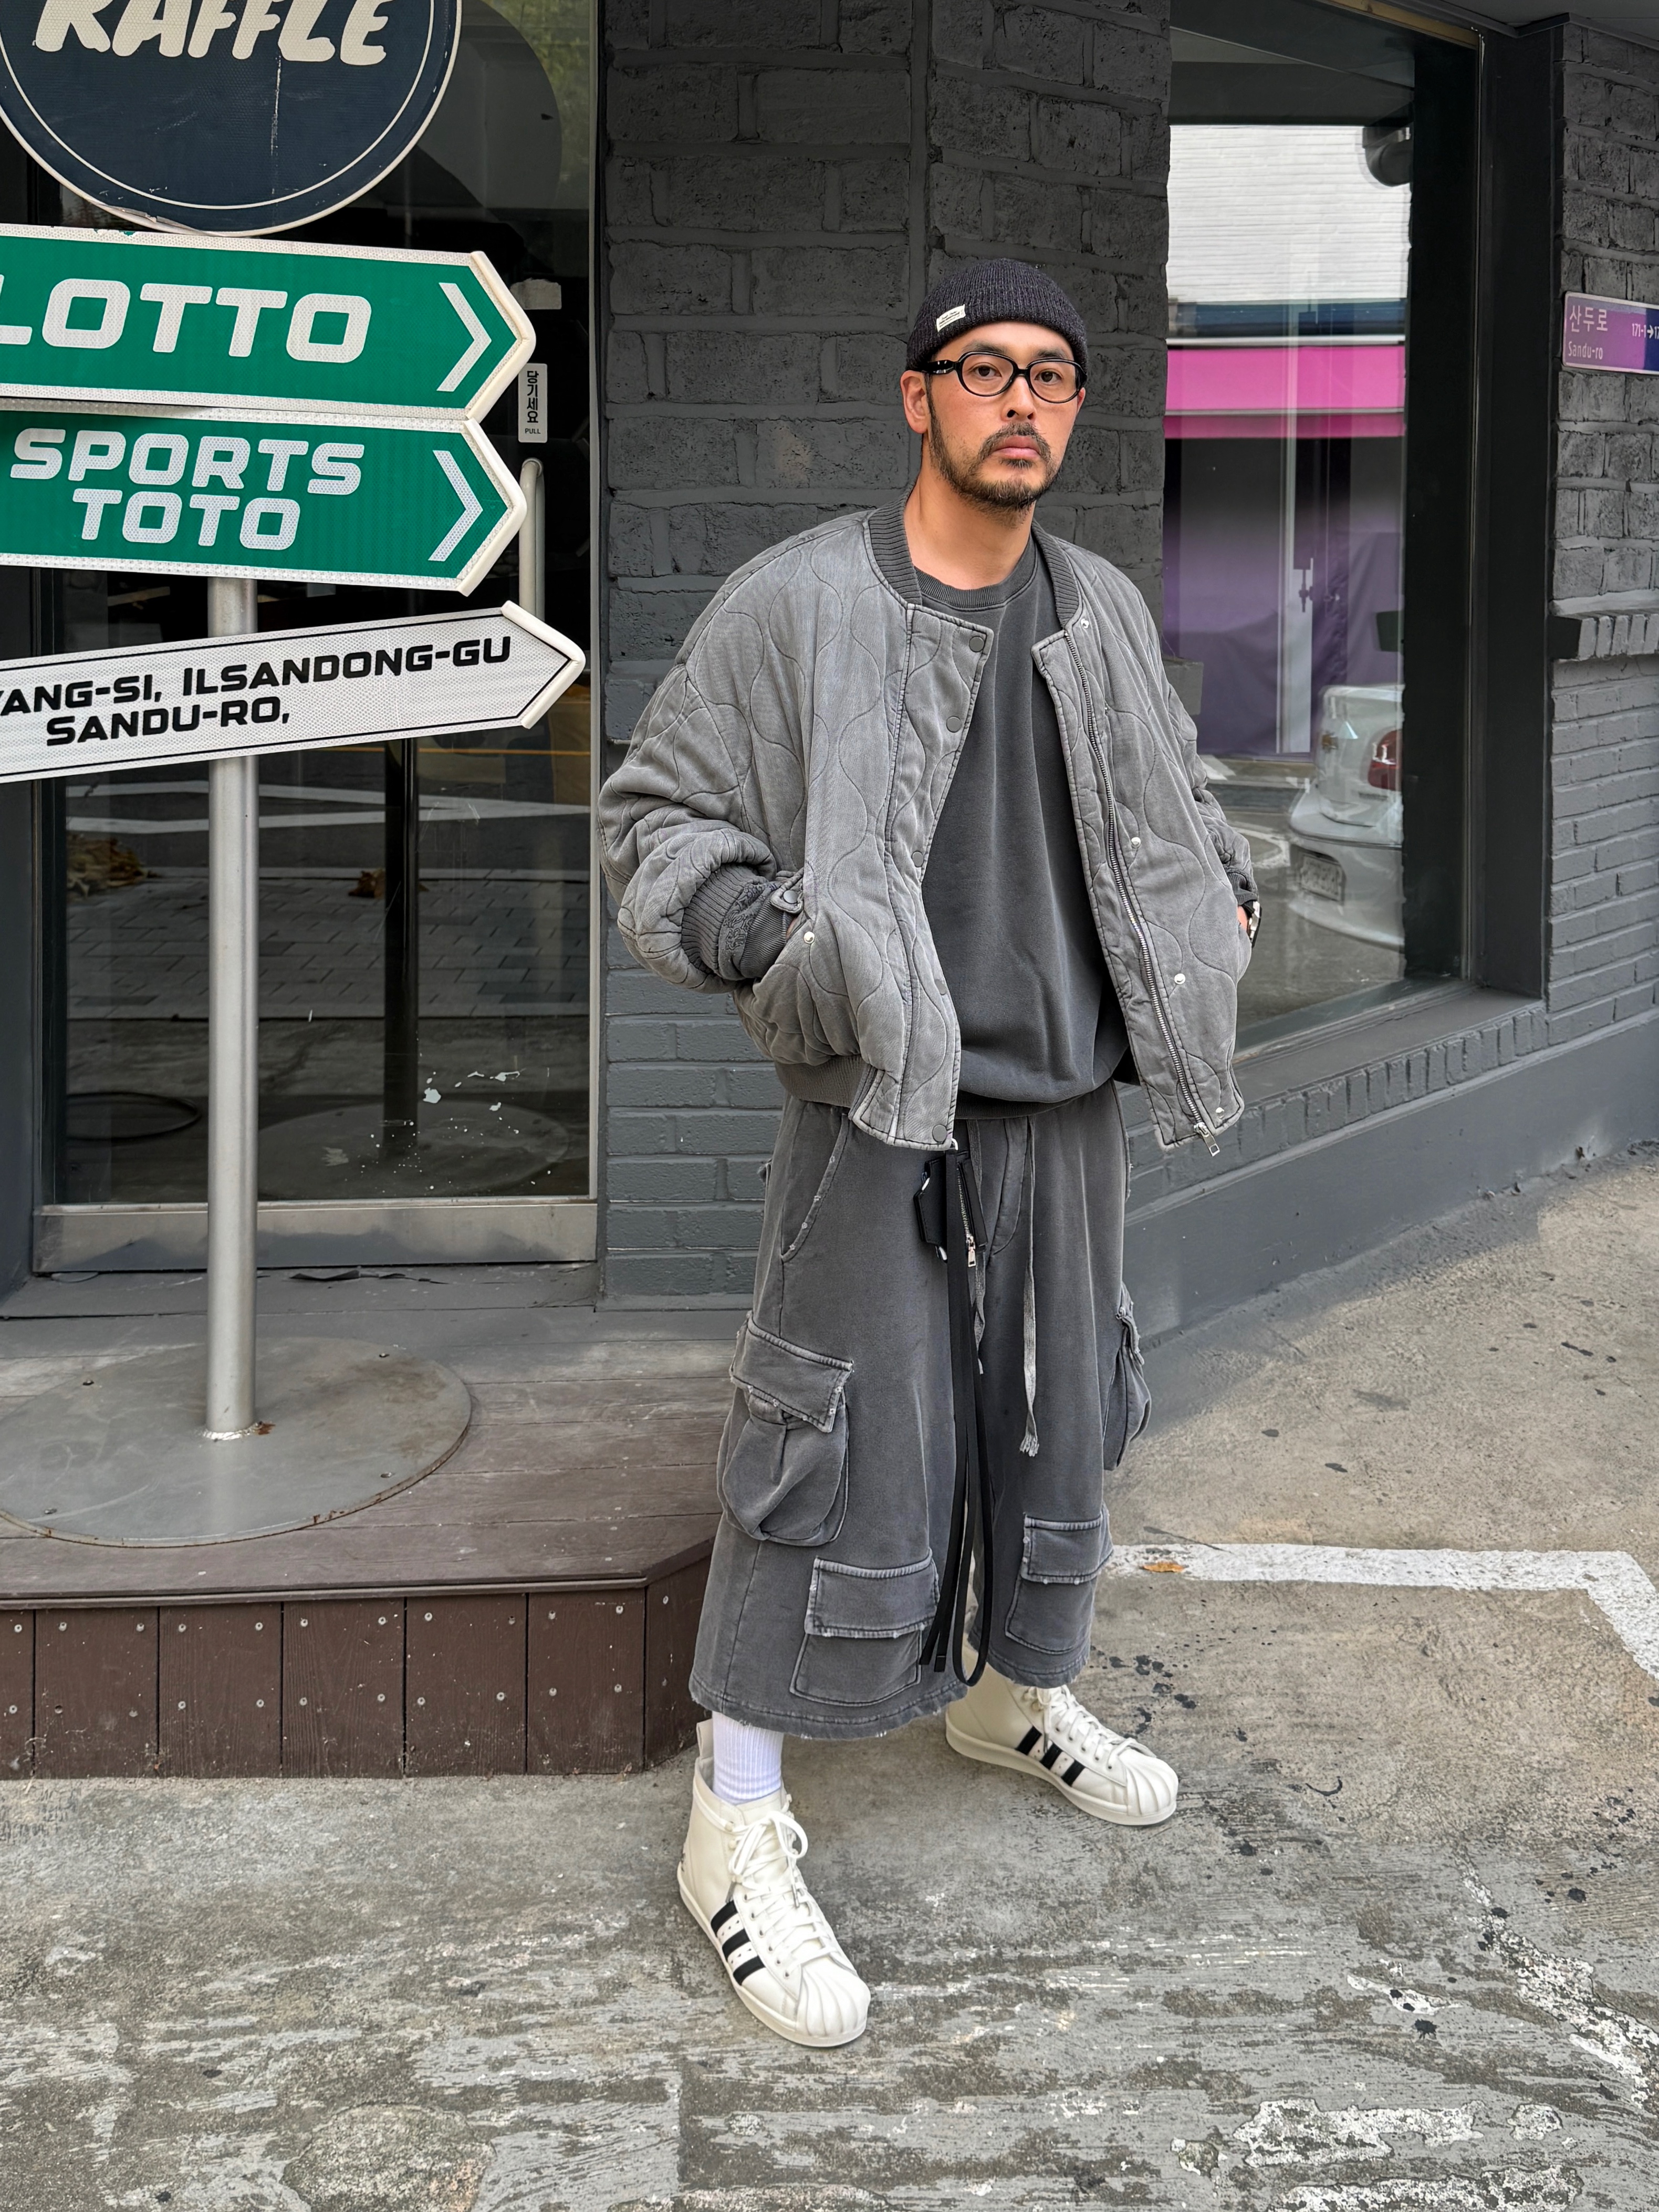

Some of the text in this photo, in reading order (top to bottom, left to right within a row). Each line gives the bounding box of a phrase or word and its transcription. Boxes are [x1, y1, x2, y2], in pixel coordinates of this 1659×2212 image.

[34, 0, 393, 65] RAFFLE
[1569, 305, 1609, 333] 산두로
[1568, 341, 1603, 360] Sandu-ro
[527, 370, 539, 423] 당기세요
[11, 429, 365, 495] SPORTS
[73, 489, 300, 550] TOTO
[0, 637, 510, 716] ANG-SI, ILSANDONG-GU
[47, 697, 289, 746] SANDU-RO,
